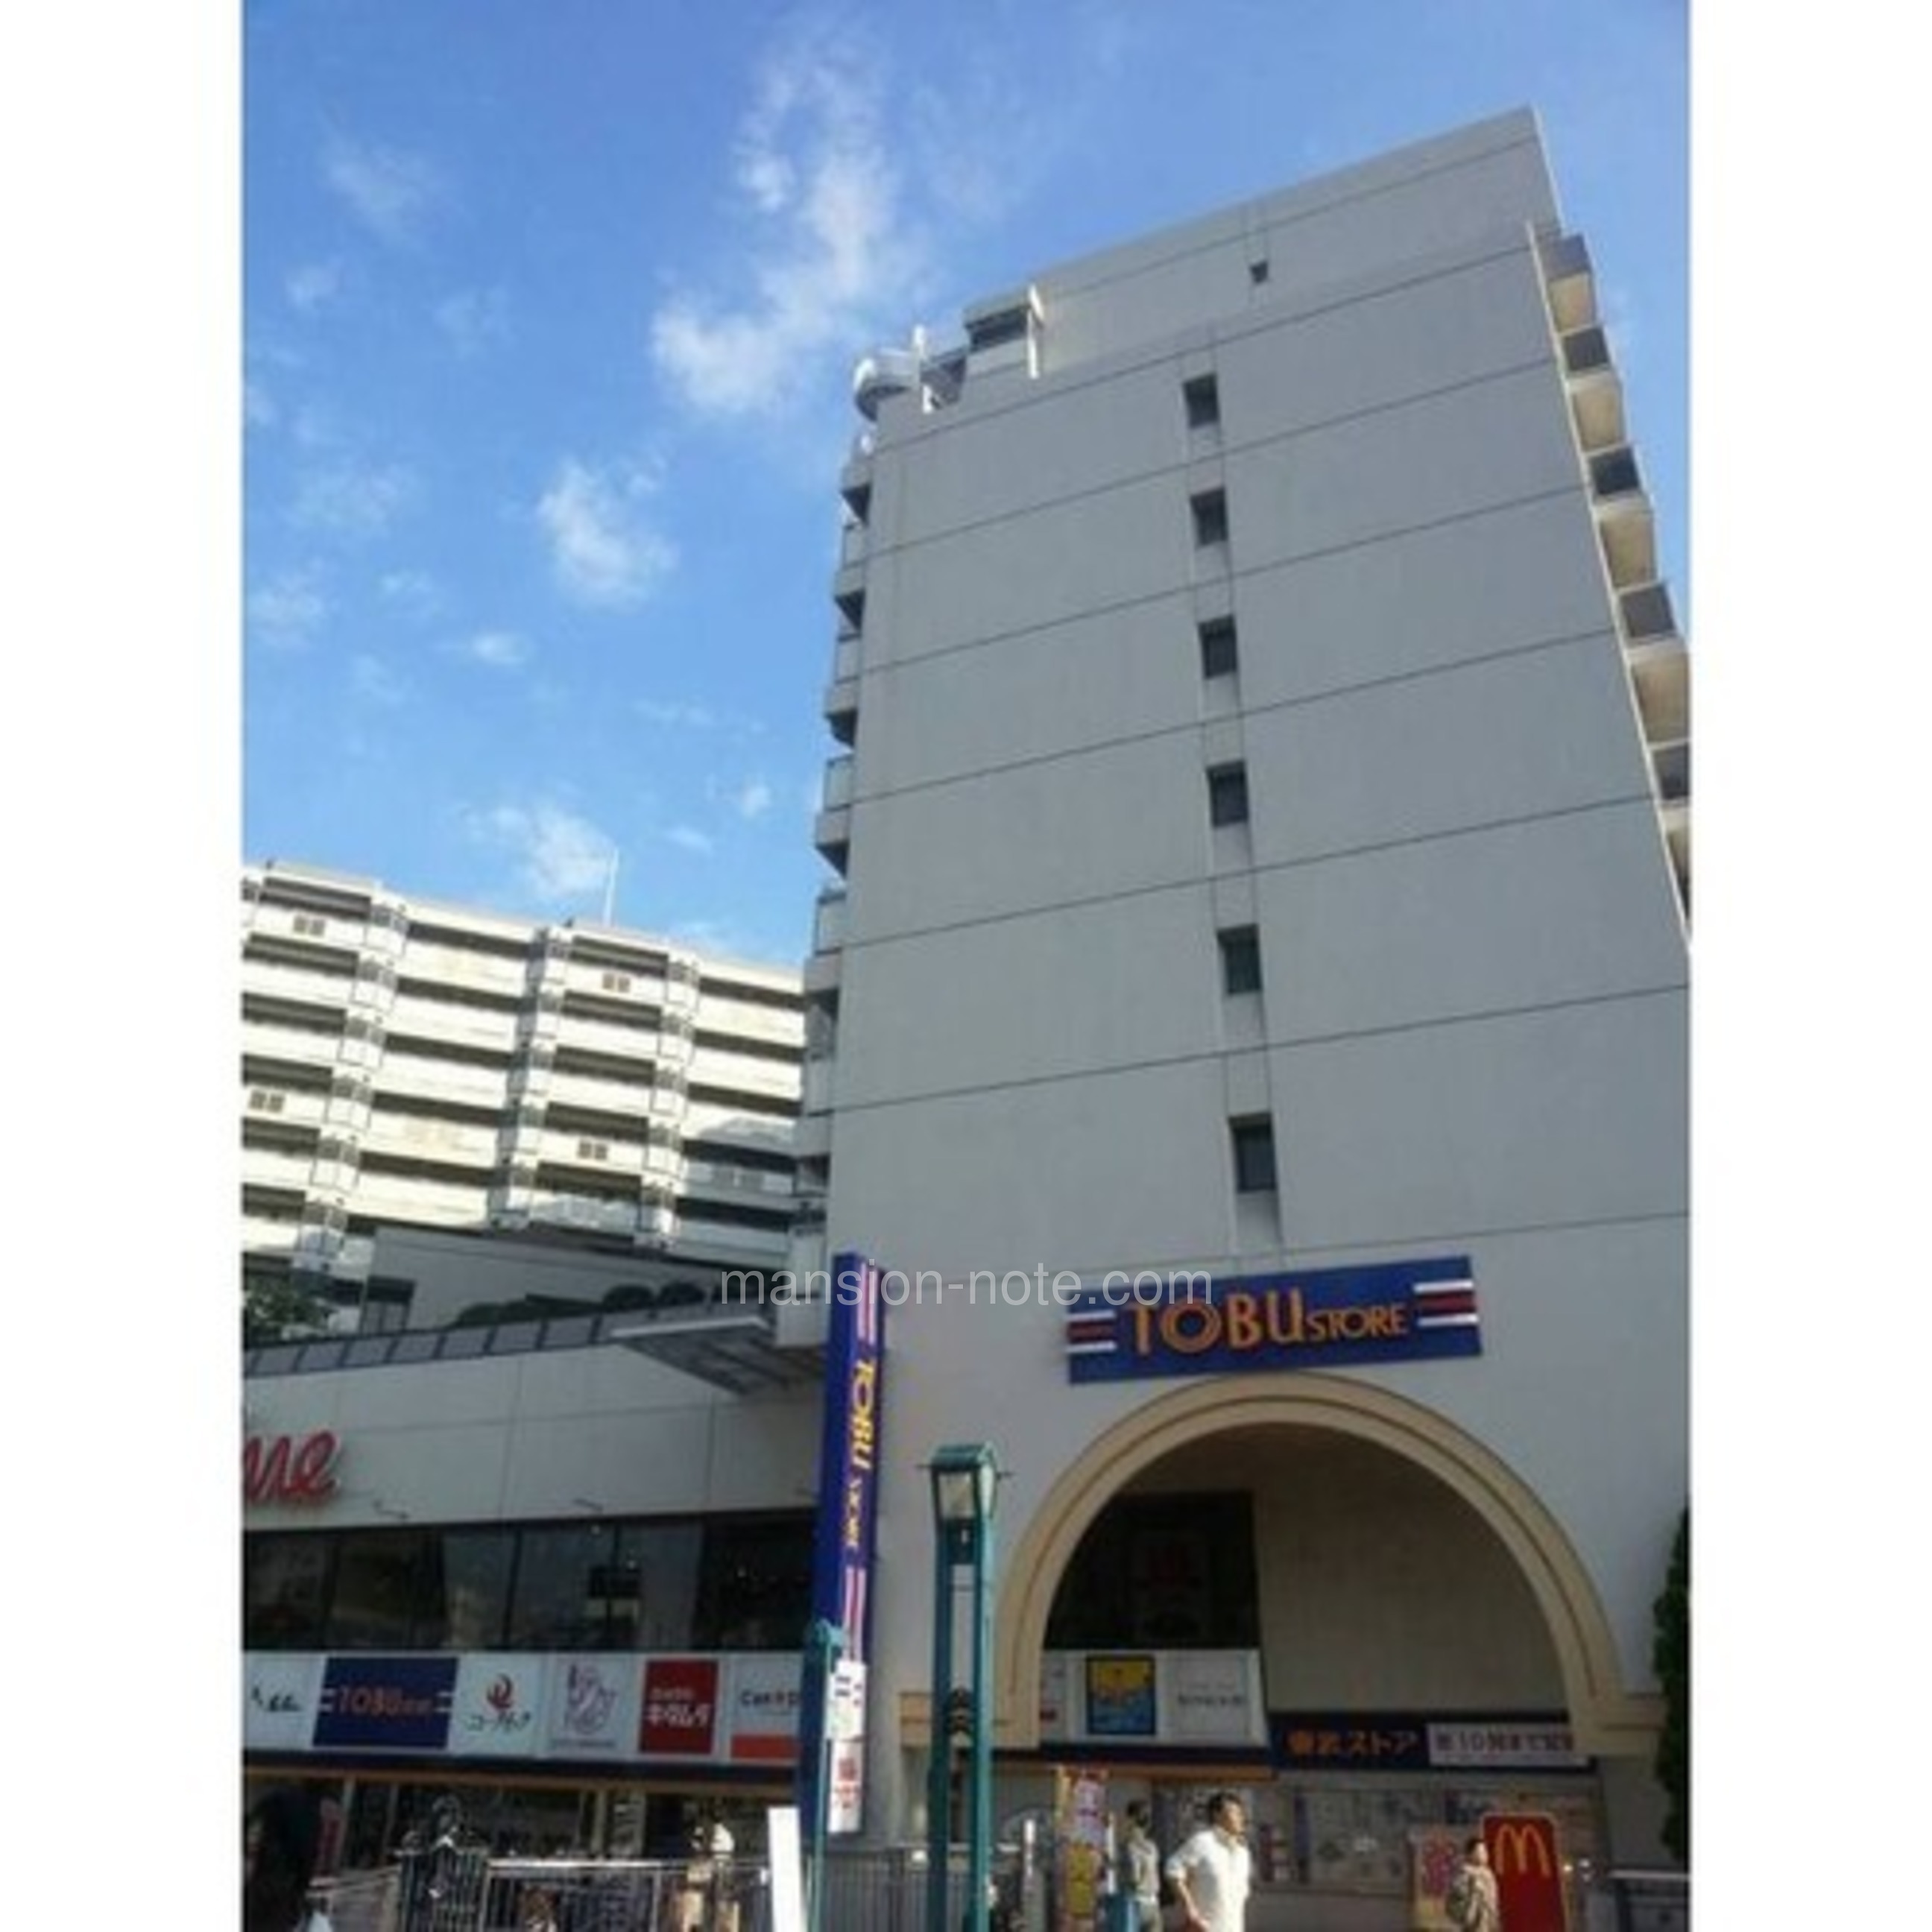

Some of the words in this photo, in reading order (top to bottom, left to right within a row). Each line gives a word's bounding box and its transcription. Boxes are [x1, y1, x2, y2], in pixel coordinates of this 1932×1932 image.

[1124, 1288, 1302, 1355] TOBU
[1306, 1303, 1410, 1341] STORE
[851, 1359, 875, 1468] TOBU
